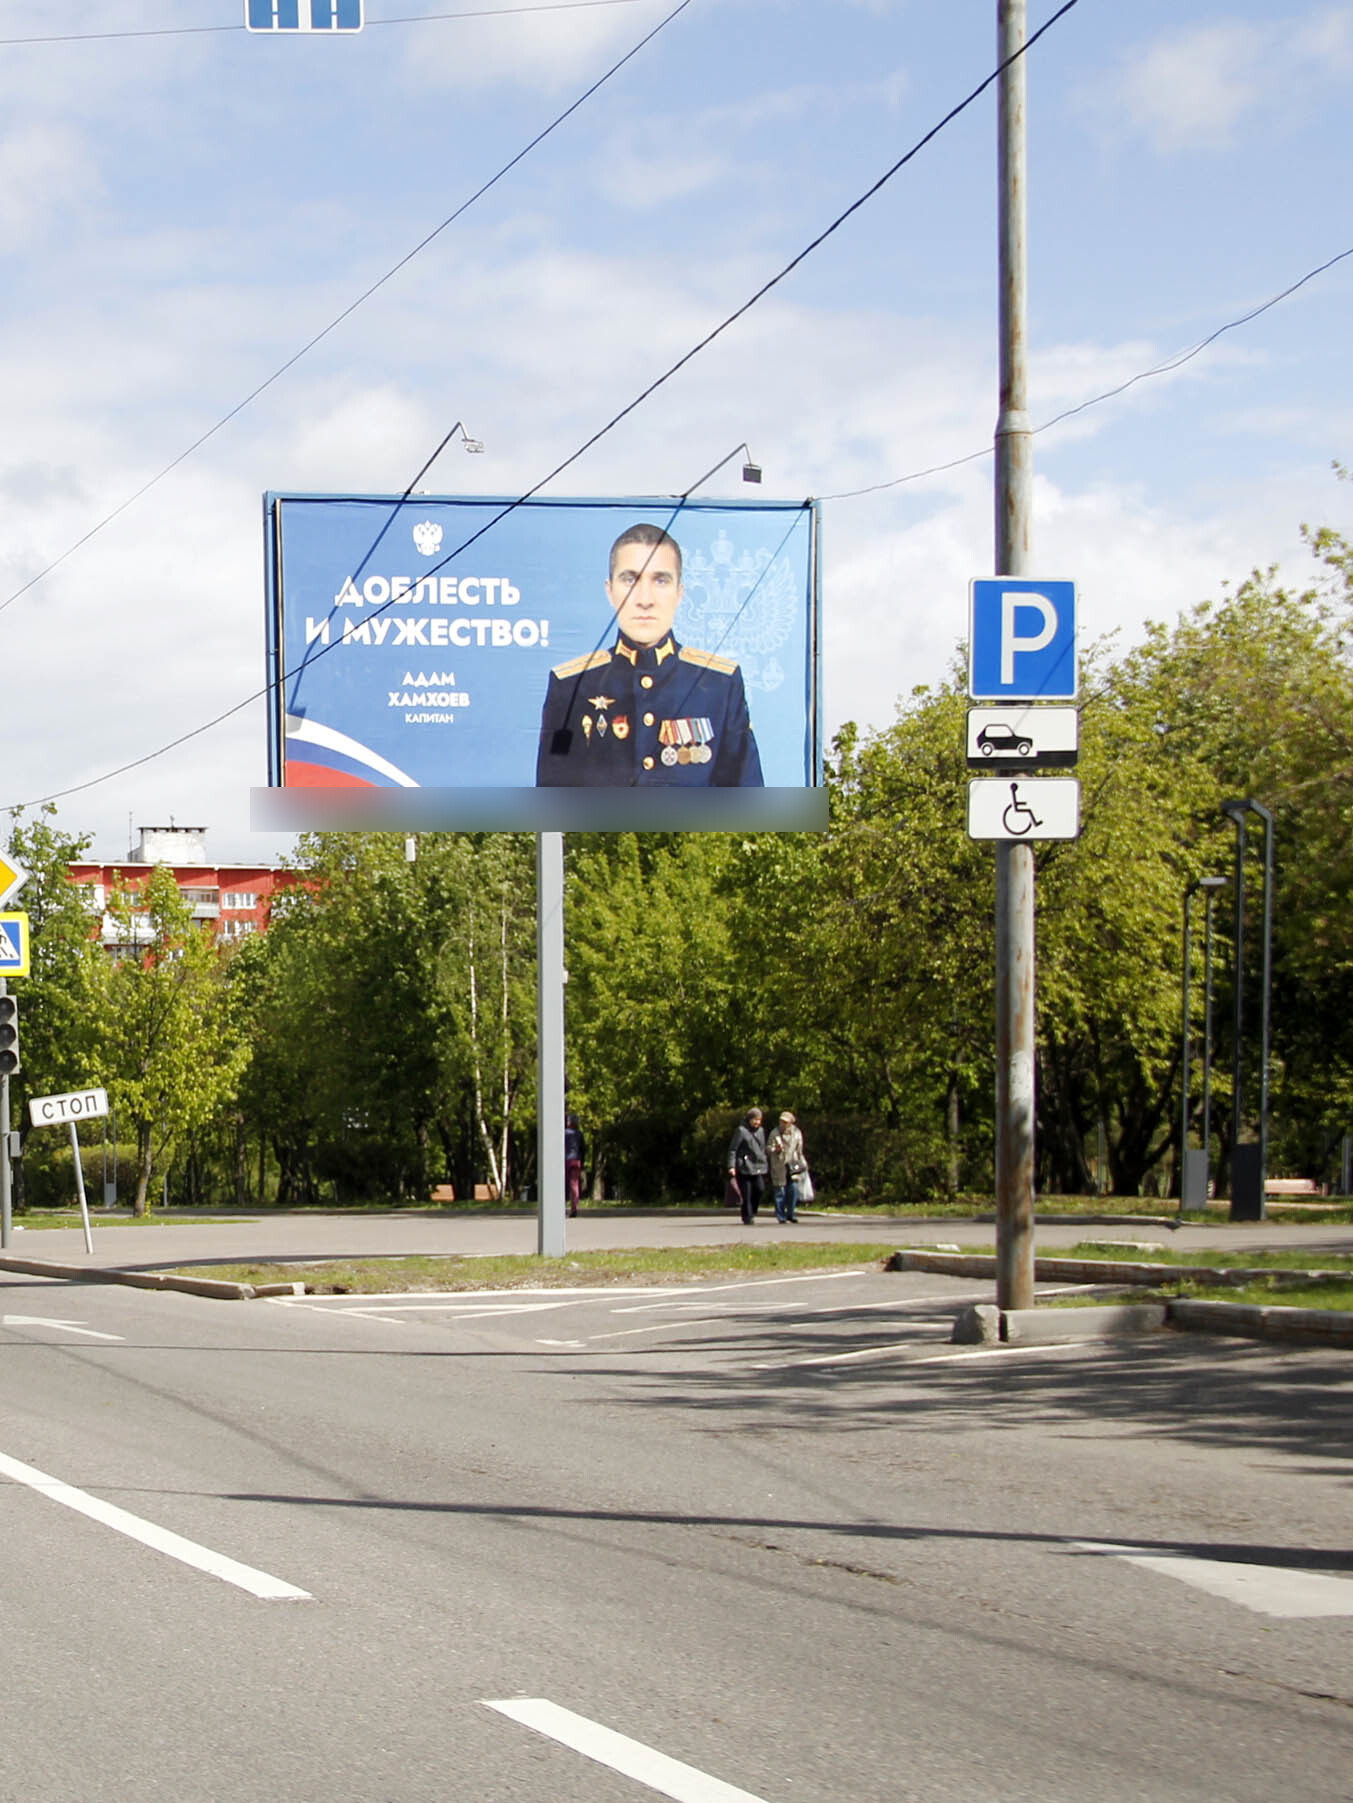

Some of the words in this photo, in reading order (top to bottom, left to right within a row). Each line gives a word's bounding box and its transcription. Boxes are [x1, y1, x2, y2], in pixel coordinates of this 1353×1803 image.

[335, 575, 521, 608] ДОБЛЕСТЬ
[305, 617, 330, 645] И
[342, 617, 550, 647] МУЖЕСТВО!
[1000, 592, 1058, 685] P
[402, 671, 456, 687] АДАМ
[387, 691, 470, 707] ХАМХОЕВ
[404, 713, 454, 724] КАПИТАН
[41, 1095, 98, 1120] СТОП
